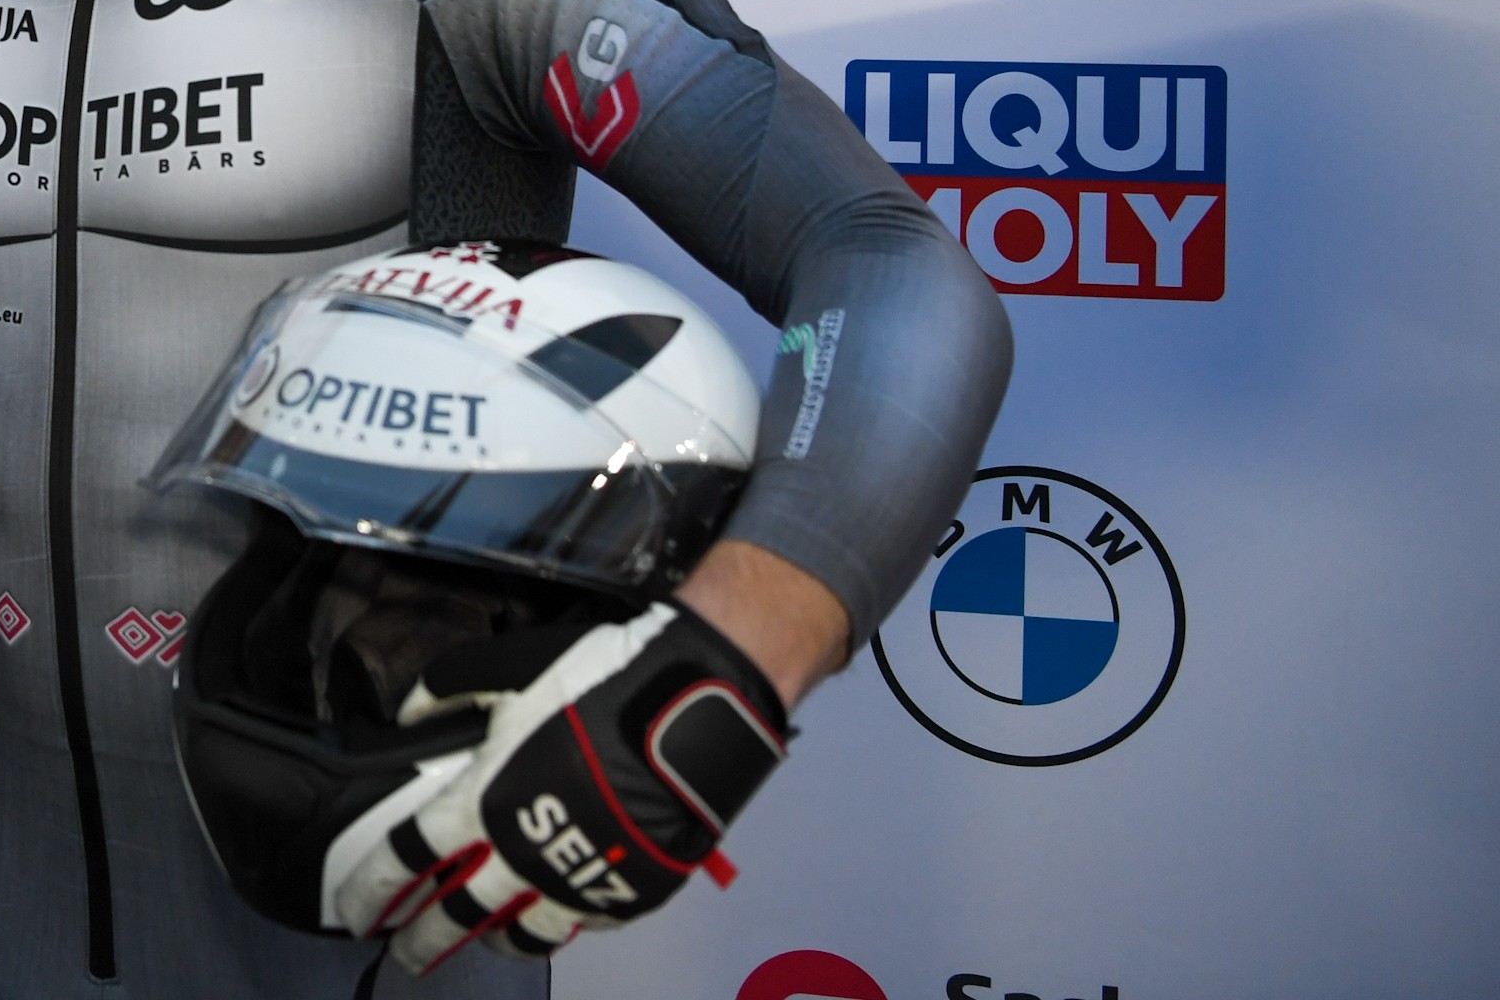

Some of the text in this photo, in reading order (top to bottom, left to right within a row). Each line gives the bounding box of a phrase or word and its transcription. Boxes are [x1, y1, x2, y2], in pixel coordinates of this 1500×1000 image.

[864, 71, 1206, 176] LIQUI
[159, 151, 266, 174] BĀRS
[277, 368, 488, 438] OPTIBET
